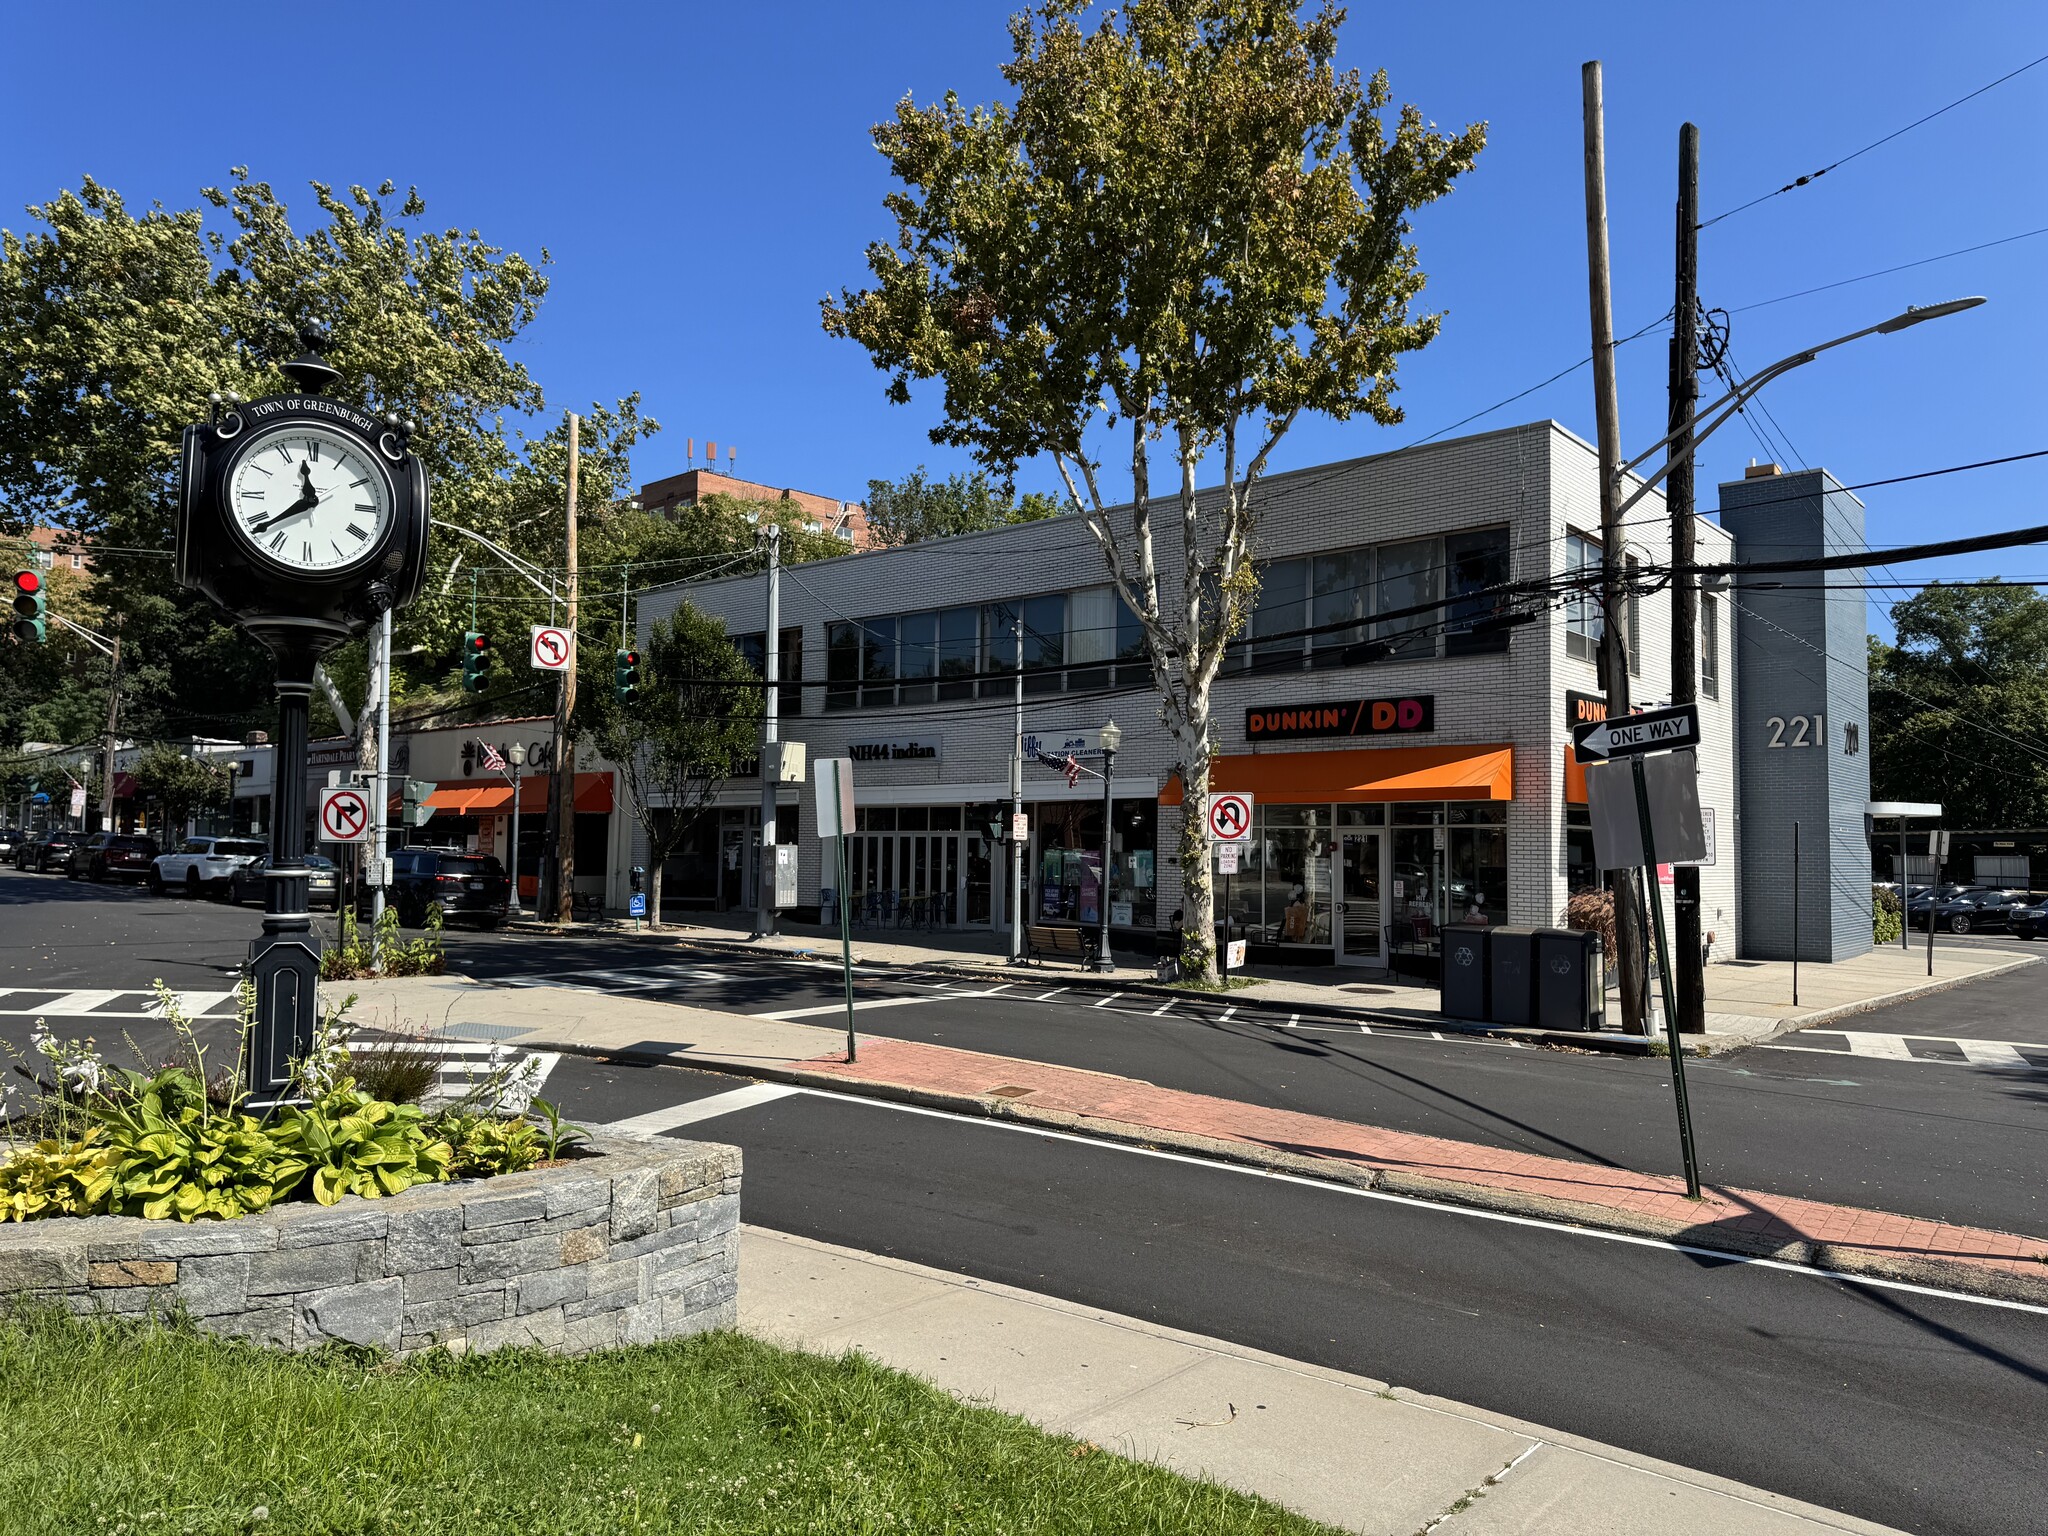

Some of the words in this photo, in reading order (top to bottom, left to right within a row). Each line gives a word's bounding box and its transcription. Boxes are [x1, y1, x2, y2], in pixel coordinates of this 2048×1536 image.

[251, 400, 284, 418] TOWN
[286, 399, 301, 410] OF
[303, 399, 374, 432] GREENBURGH
[1250, 708, 1348, 733] DUNKIN'
[1372, 700, 1423, 730] DD
[1577, 699, 1607, 722] DUNK
[1610, 727, 1643, 746] ONE
[1649, 718, 1684, 739] WAY
[1766, 714, 1823, 748] 221
[311, 752, 339, 764] HARTSDALE
[848, 744, 889, 762] NH44
[892, 742, 936, 759] indian
